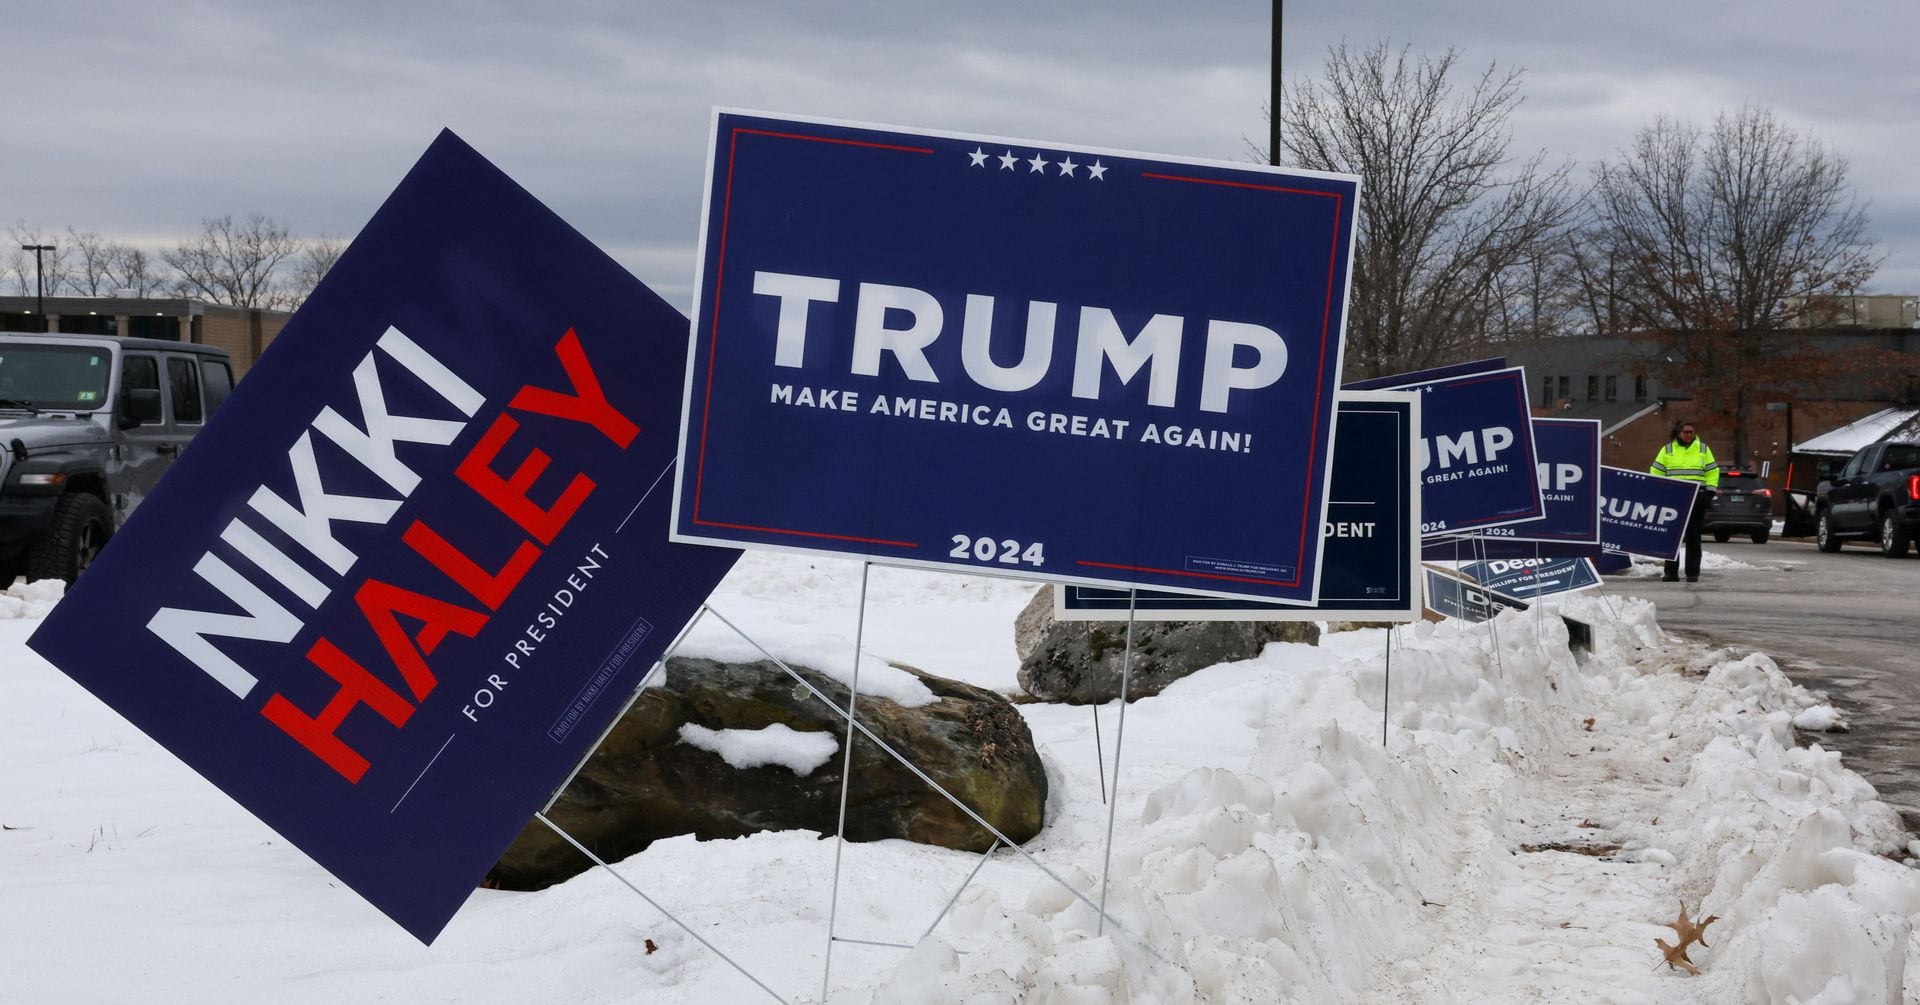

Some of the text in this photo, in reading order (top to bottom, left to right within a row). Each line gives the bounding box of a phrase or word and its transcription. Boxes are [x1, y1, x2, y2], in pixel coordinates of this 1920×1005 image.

[752, 270, 1288, 413] TRUMP
[770, 383, 1253, 454] MAKE AMERICA GREAT AGAIN!
[1427, 464, 1508, 484] GREAT AGAIN!
[146, 325, 487, 699] NIKKI
[1421, 520, 1447, 532] 024
[1486, 528, 1515, 536] 2024
[1620, 520, 1642, 528] GREAT
[1644, 525, 1668, 533] AGAIN!
[260, 326, 641, 785] HALEY
[949, 534, 1045, 567] 2024
[463, 542, 610, 723] FOR PRESIDENT
[553, 623, 648, 738] PAID FOR BY NIKKI HALEY FOR PRESIDENT
